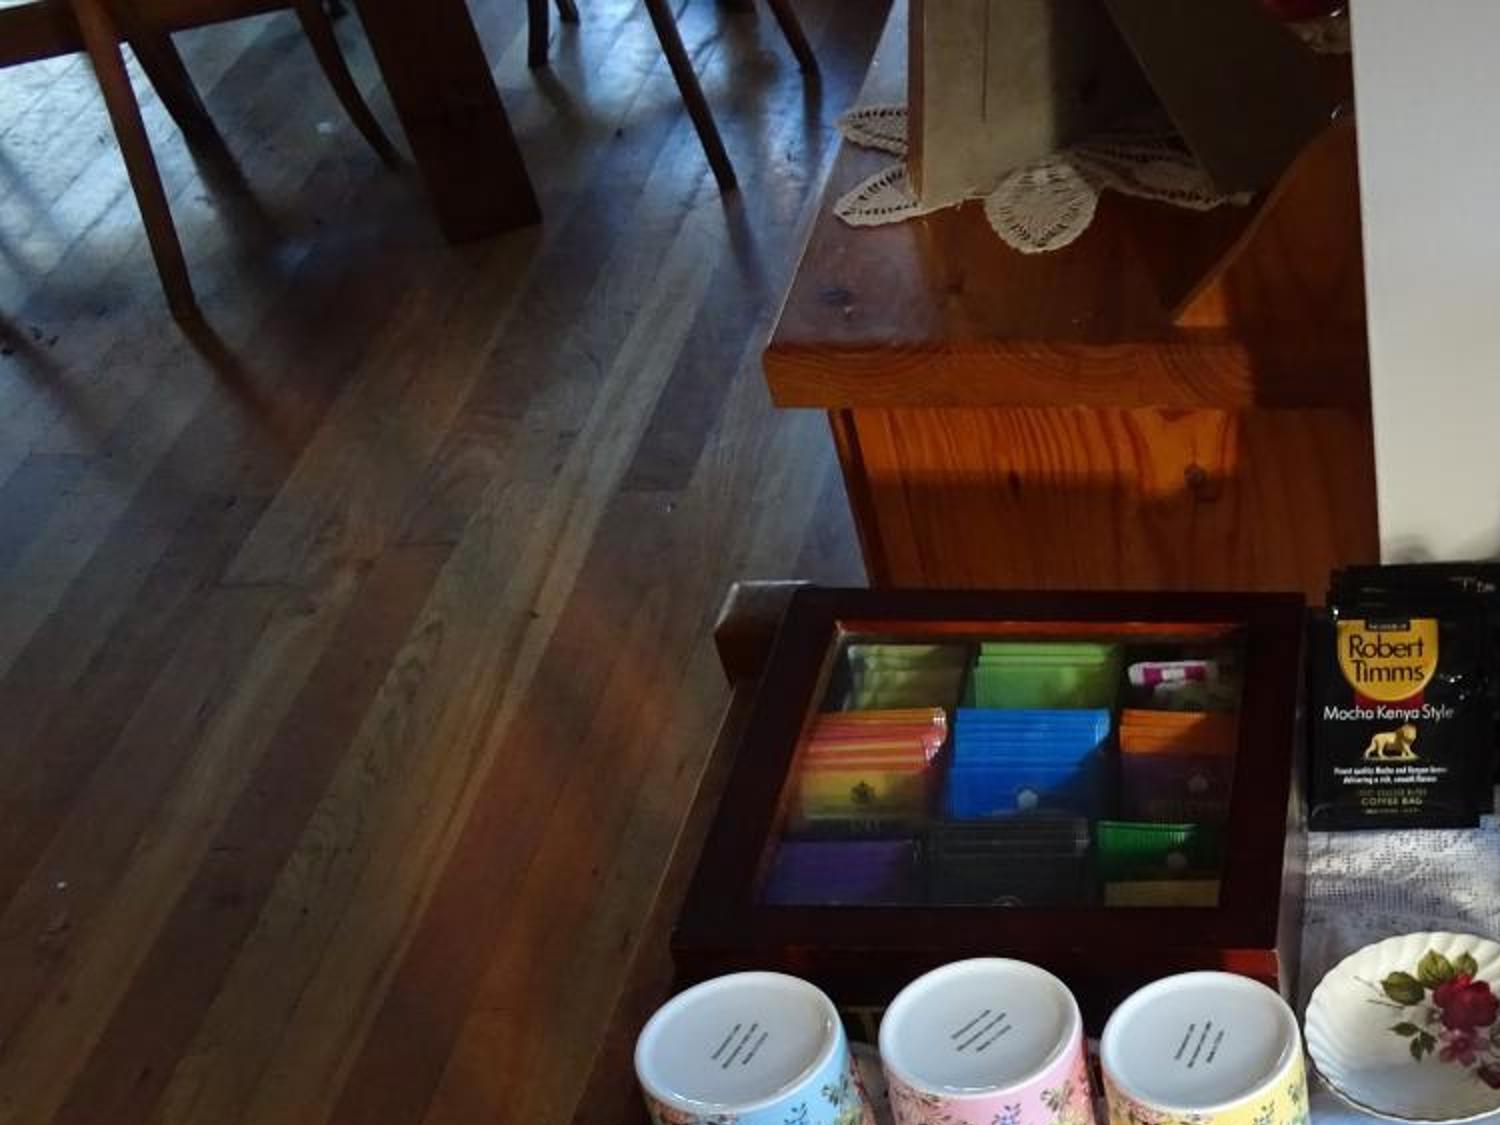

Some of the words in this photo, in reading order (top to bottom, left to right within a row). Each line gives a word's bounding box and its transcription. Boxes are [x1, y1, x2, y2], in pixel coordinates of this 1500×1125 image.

[1349, 634, 1424, 659] Robert
[1351, 660, 1424, 682] Timms
[1323, 706, 1374, 720] Mocha
[1376, 704, 1419, 721] Kenya
[1421, 704, 1454, 722] Style
